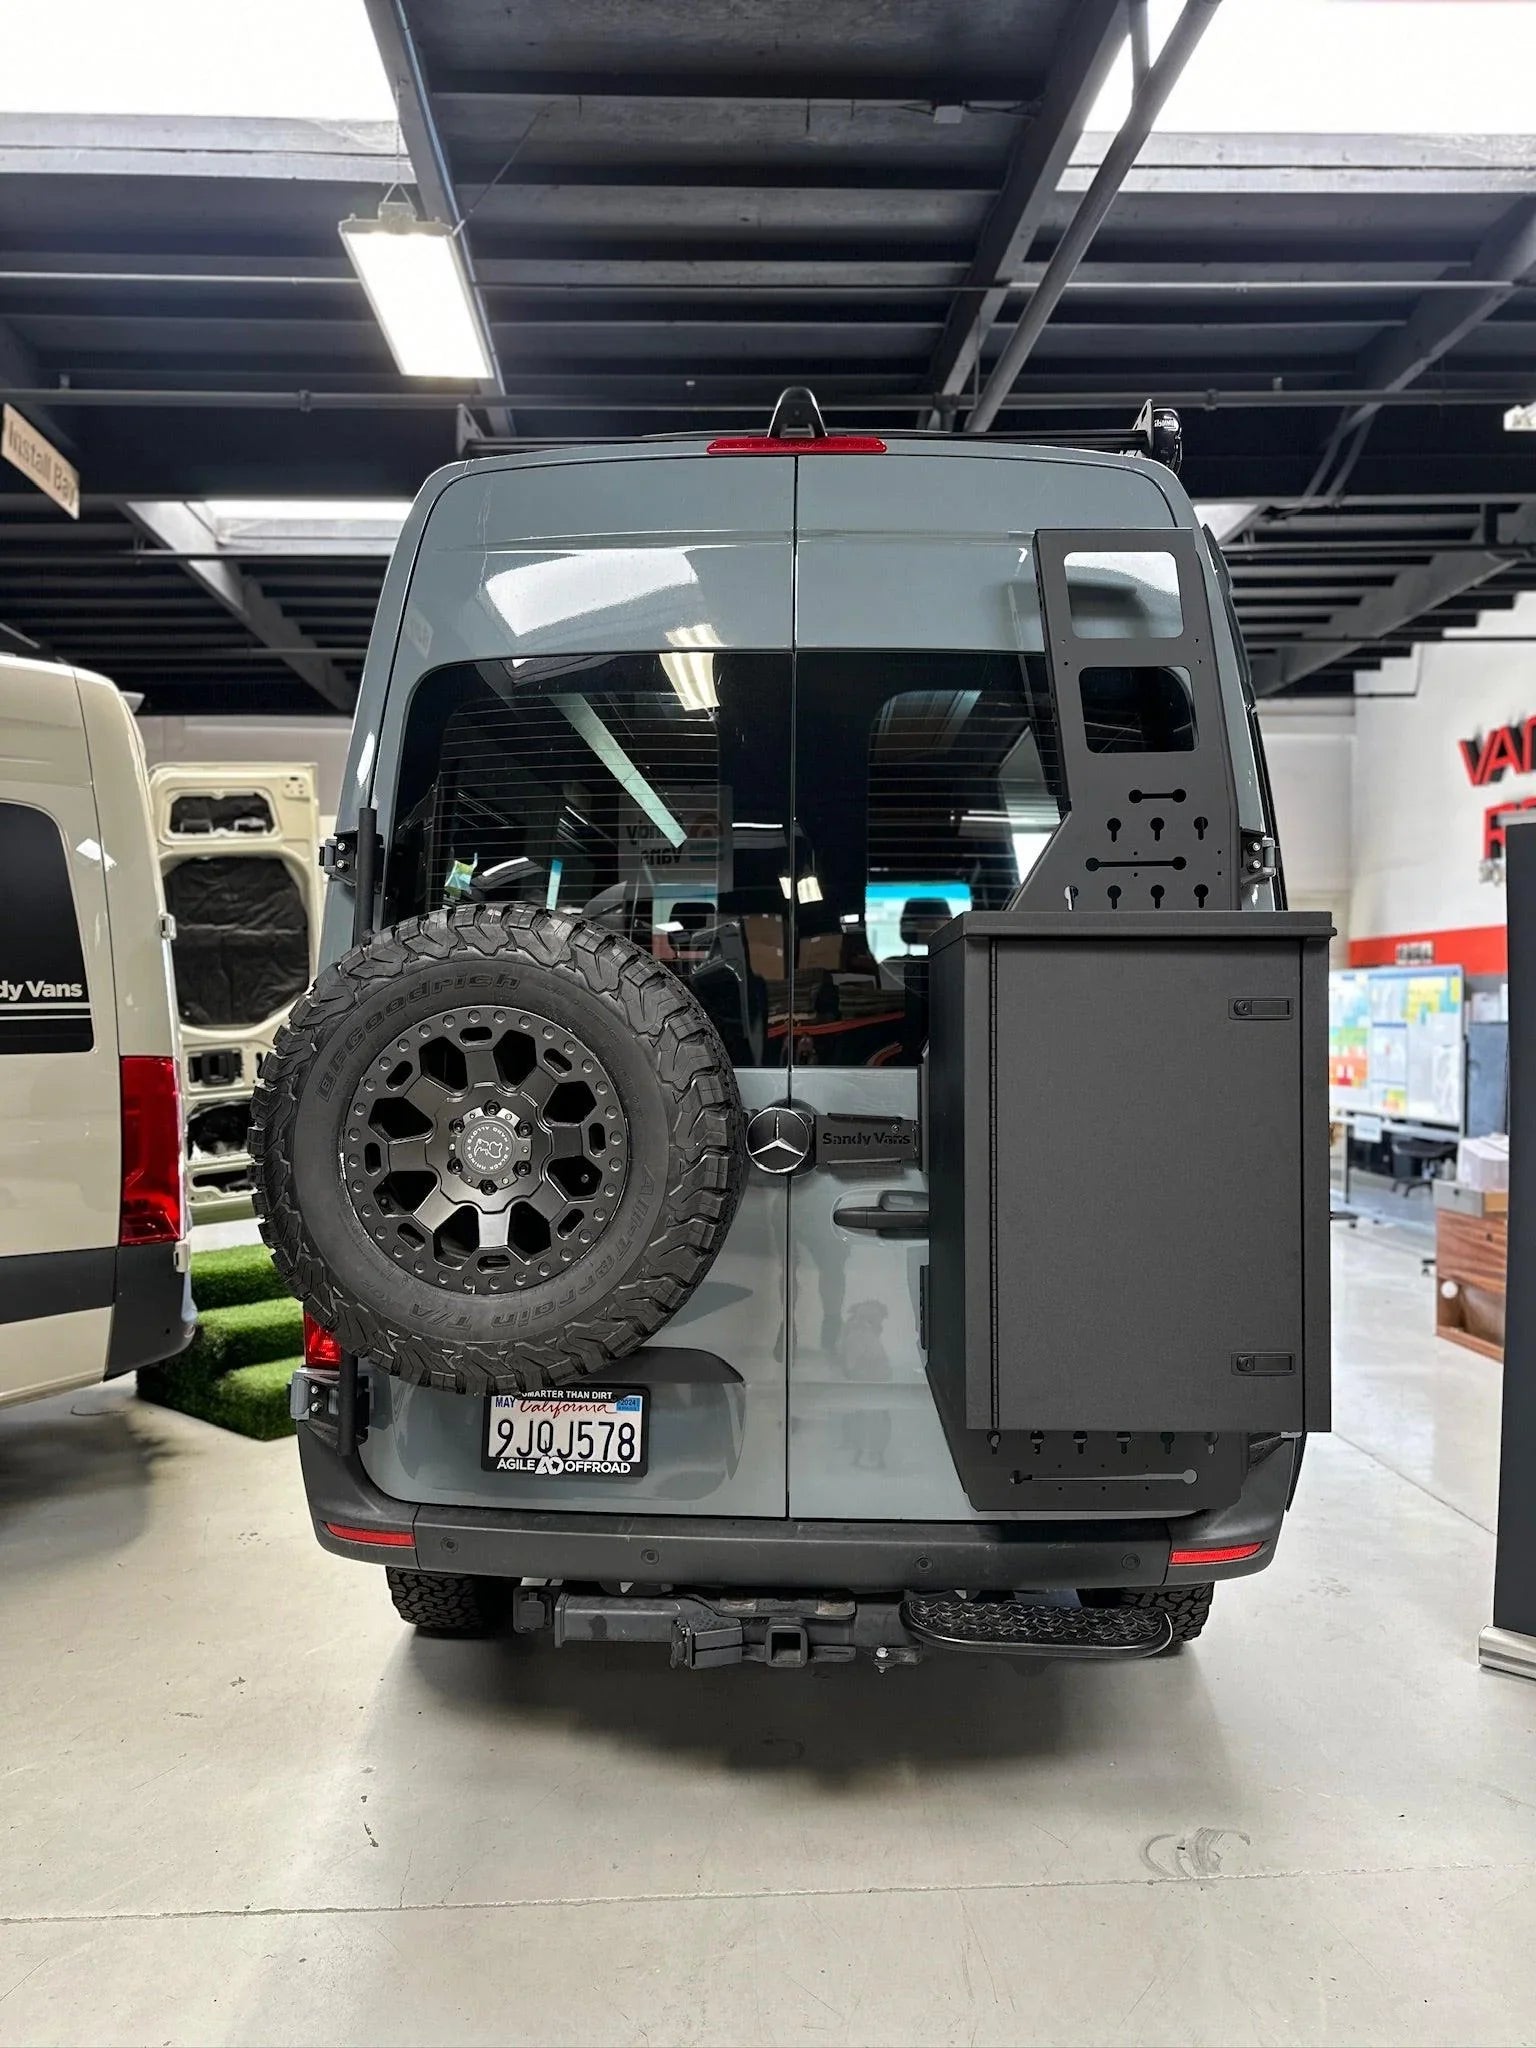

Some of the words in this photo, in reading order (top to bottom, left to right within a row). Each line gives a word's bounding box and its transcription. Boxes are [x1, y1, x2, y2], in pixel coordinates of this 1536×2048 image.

[8, 420, 52, 483] Install
[54, 462, 76, 507] Bay
[25, 980, 83, 998] Vans
[315, 972, 520, 1103] BFGoodrich
[822, 1132, 871, 1146] Sandy
[873, 1132, 912, 1145] Vans
[495, 1397, 516, 1408] MAY
[566, 1390, 590, 1400] THAN
[592, 1391, 613, 1400] DIRT
[520, 1399, 617, 1419] California
[496, 1418, 635, 1462] 9JQJ578
[497, 1458, 536, 1471] AGILE
[564, 1460, 631, 1474] OFFROAD
